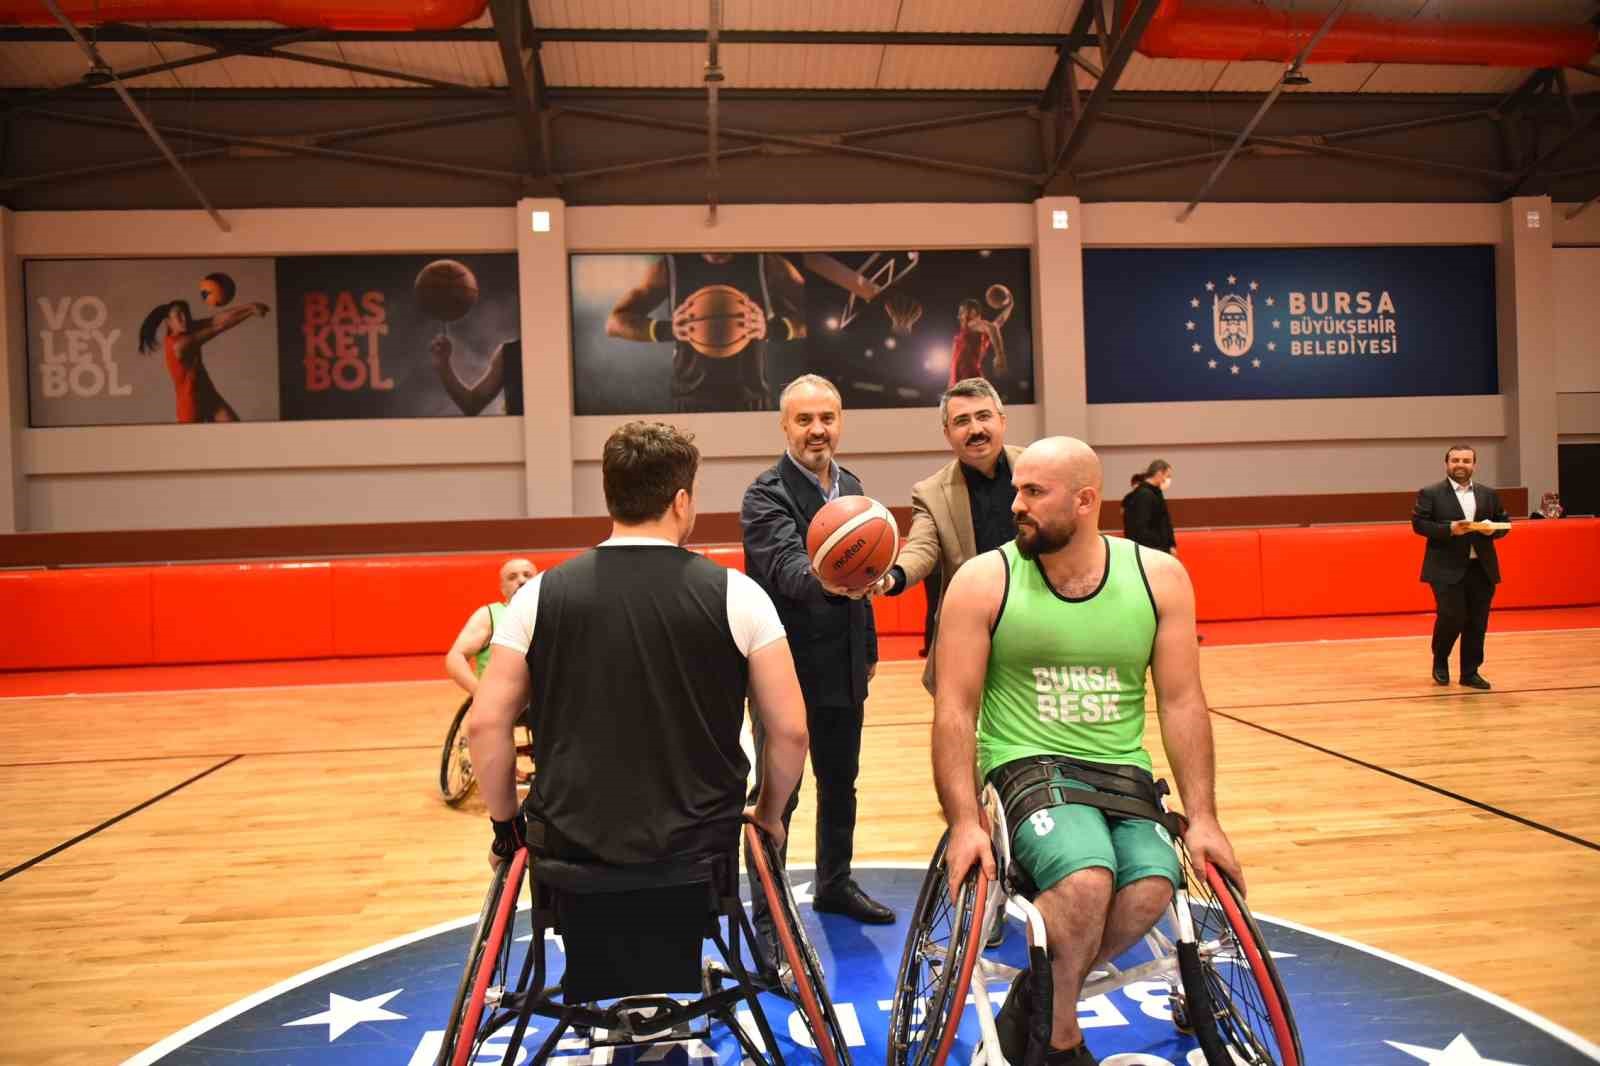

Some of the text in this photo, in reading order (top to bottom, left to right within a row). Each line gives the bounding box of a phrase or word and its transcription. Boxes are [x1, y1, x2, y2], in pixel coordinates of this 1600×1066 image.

[38, 296, 106, 330] VO
[304, 291, 386, 325] BAS
[1288, 291, 1395, 314] BURSA
[304, 324, 388, 358] KET
[1290, 314, 1396, 337] BÜYÜKŞEHİR
[40, 329, 121, 363] LEY
[1290, 335, 1397, 355] BELEDİYESİ
[41, 362, 132, 397] BOL
[304, 357, 393, 391] BOL
[1032, 665, 1121, 692] BURSA
[1037, 693, 1121, 722] BESK
[1029, 808, 1056, 836] 8
